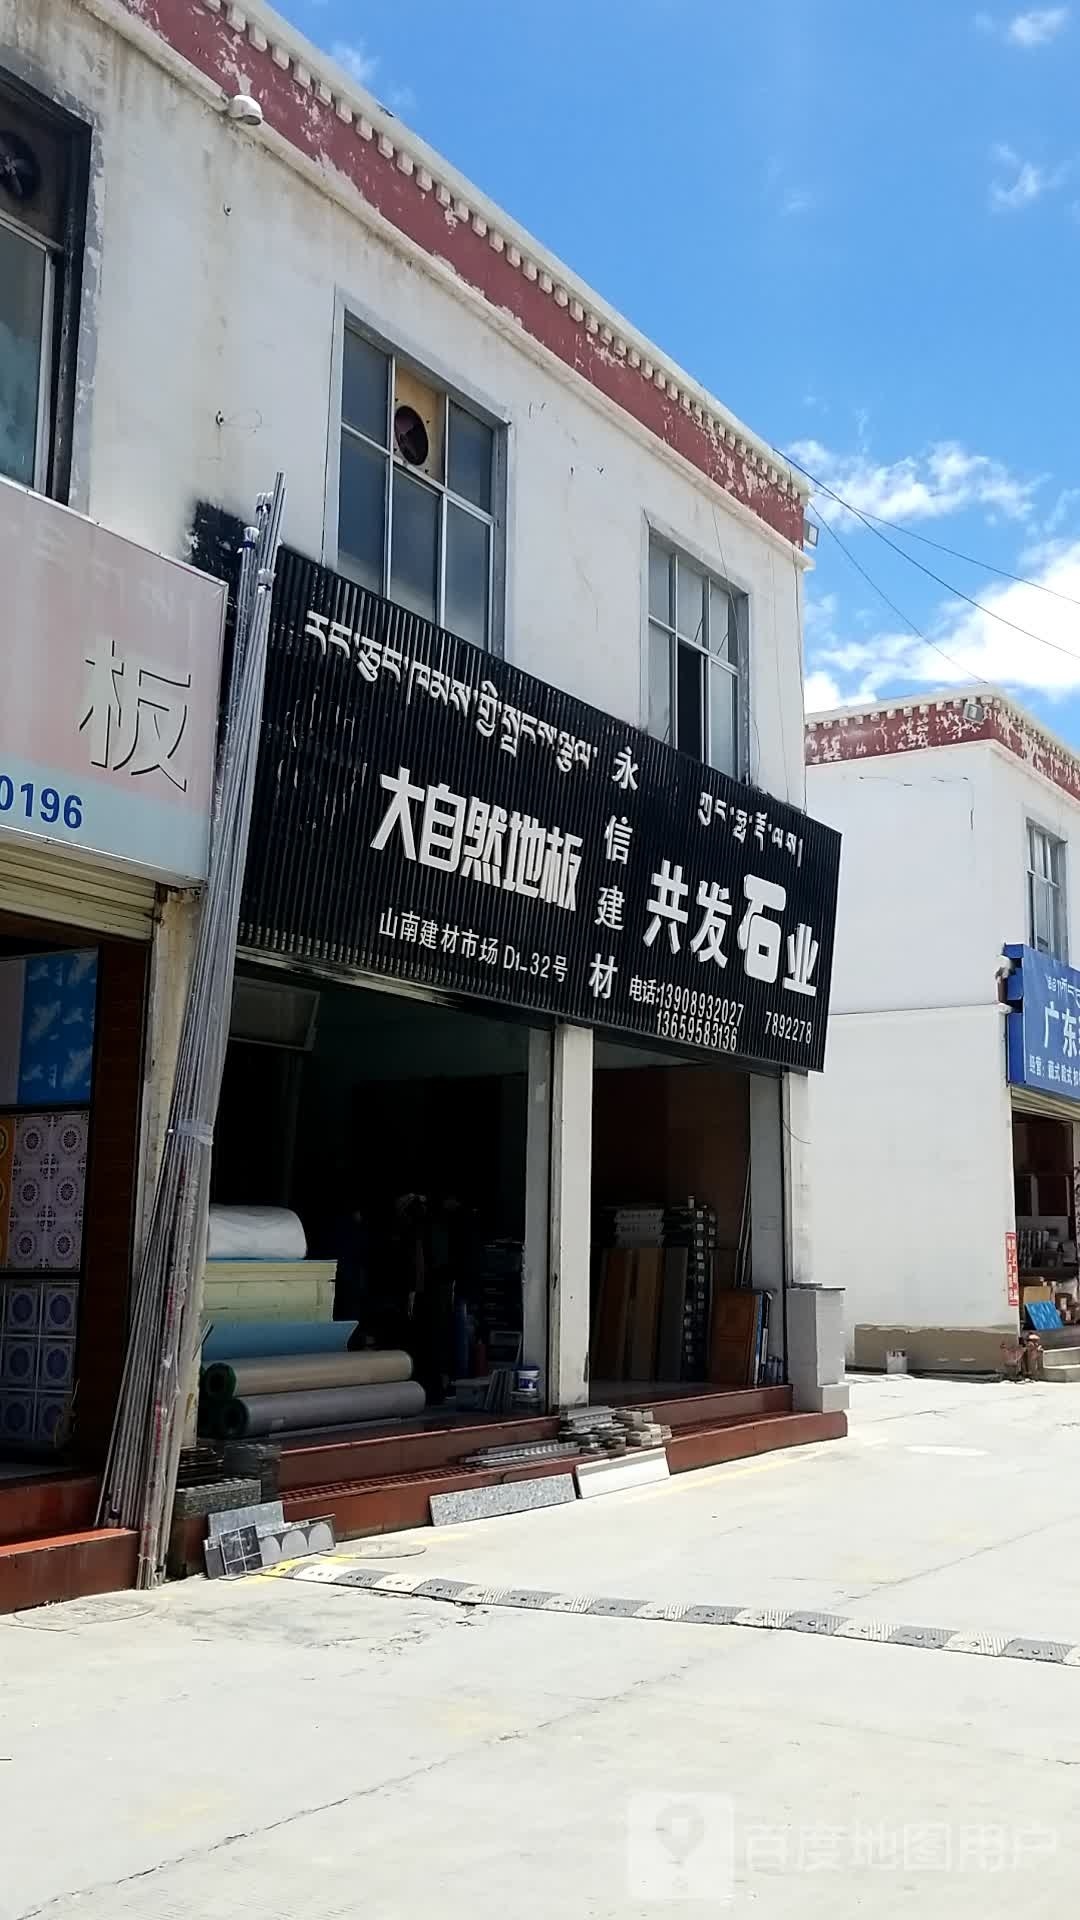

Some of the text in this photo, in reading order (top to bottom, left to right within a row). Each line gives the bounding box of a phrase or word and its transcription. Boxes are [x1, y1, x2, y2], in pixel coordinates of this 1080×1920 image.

[78, 640, 191, 793] 板
[370, 766, 584, 912] 大自然地板
[588, 746, 639, 1000] 永信建材
[642, 859, 819, 998] 共发石业
[655, 1008, 738, 1052] 13659583136
[764, 1011, 813, 1045] 7892278
